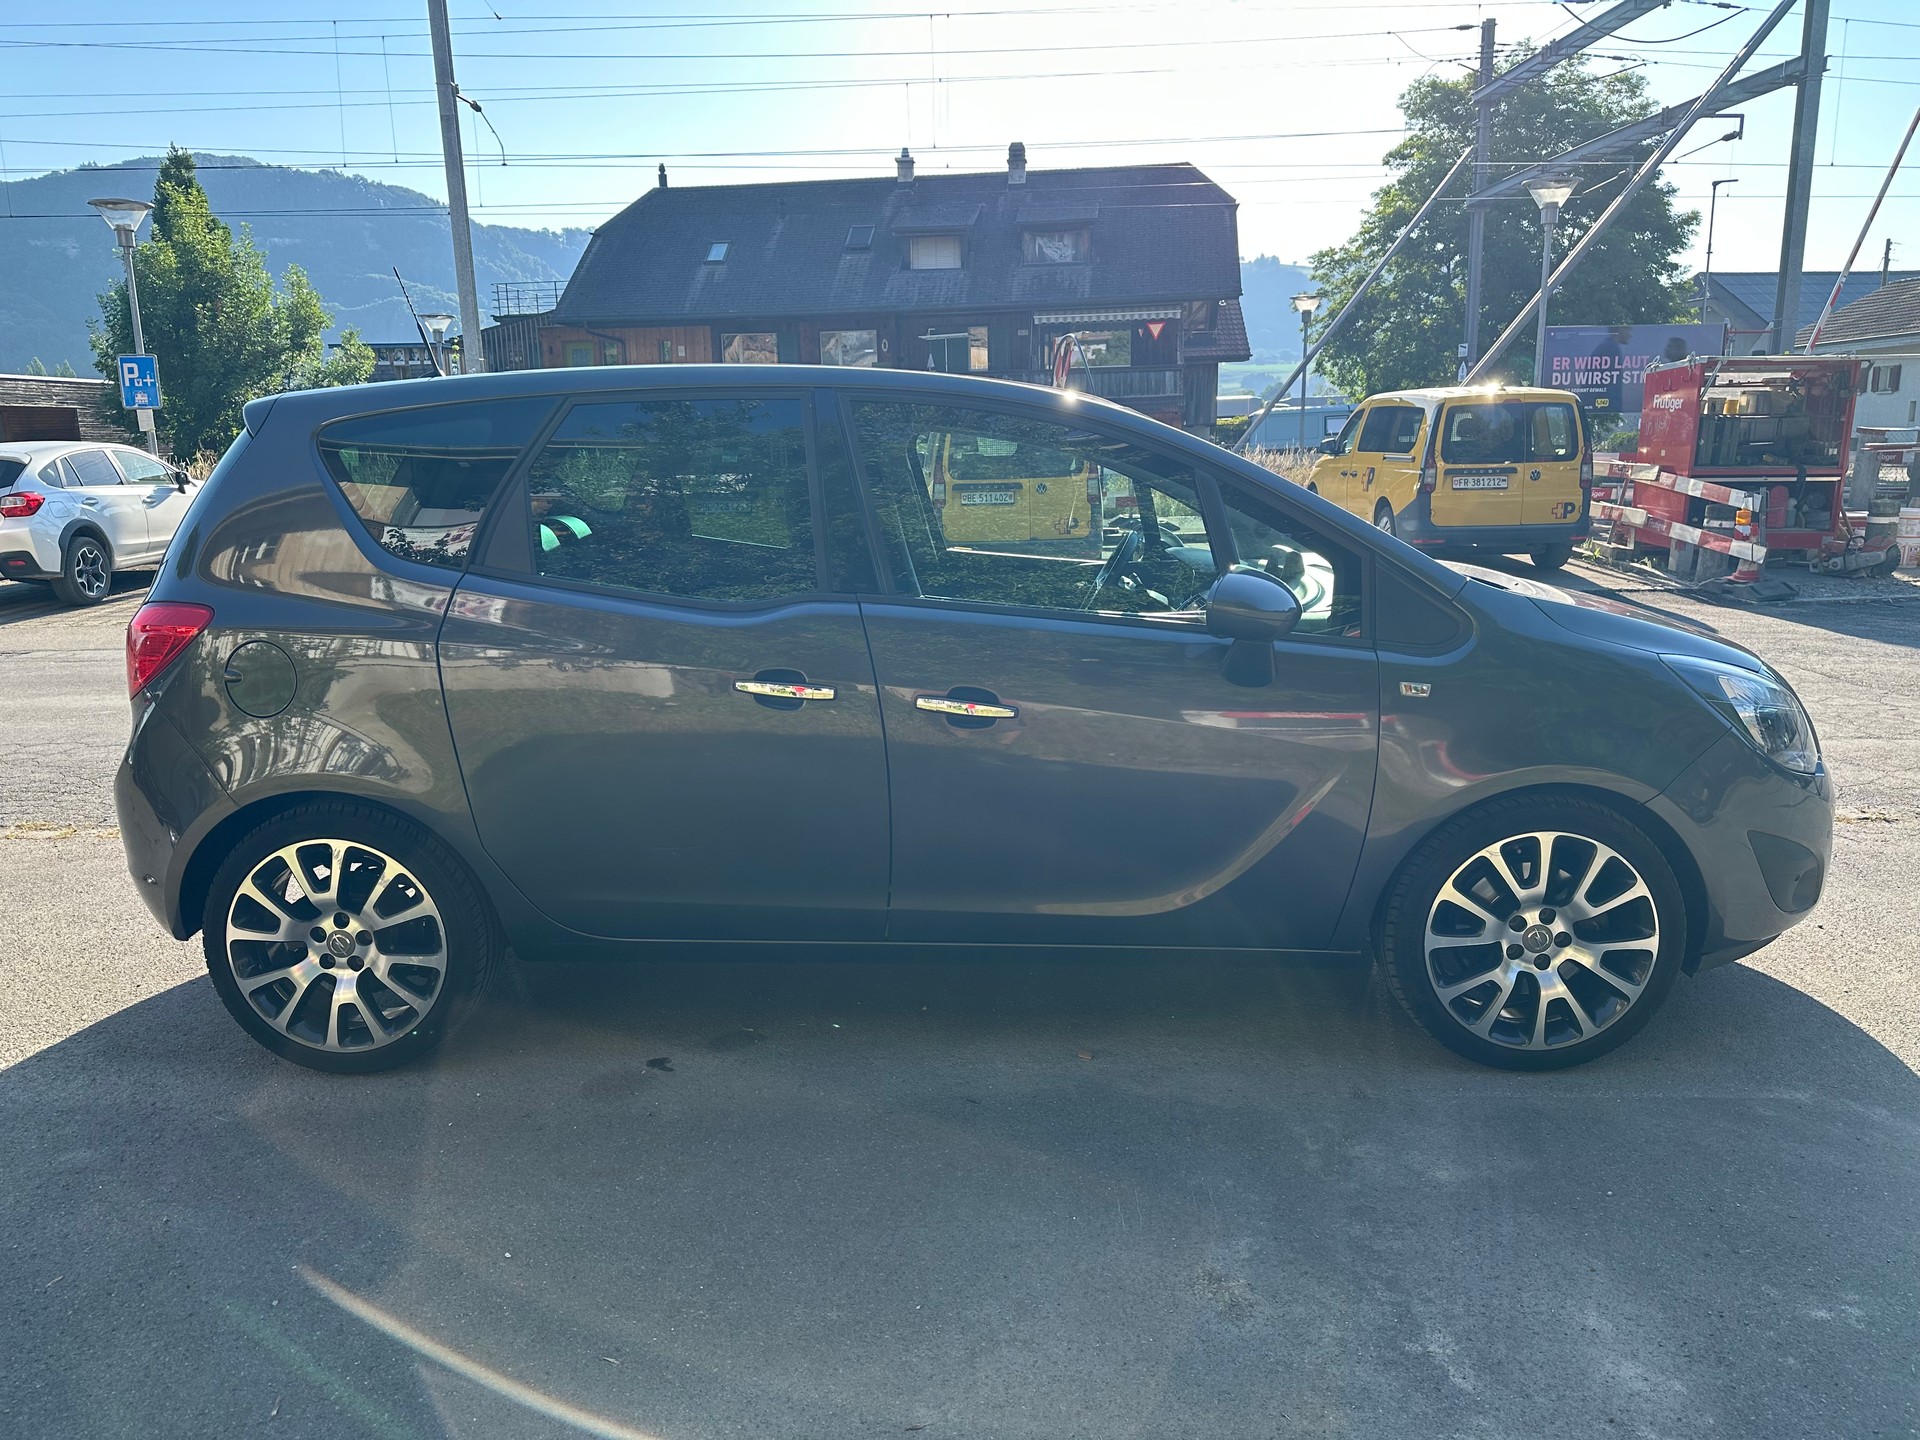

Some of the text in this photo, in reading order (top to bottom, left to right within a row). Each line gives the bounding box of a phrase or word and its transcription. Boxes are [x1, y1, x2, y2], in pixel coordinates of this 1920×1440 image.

[1553, 357, 1570, 370] ER
[1574, 356, 1611, 369] WIRD
[1552, 372, 1571, 386] DU
[1575, 371, 1620, 385] WIRST
[1653, 394, 1684, 412] Frutiger
